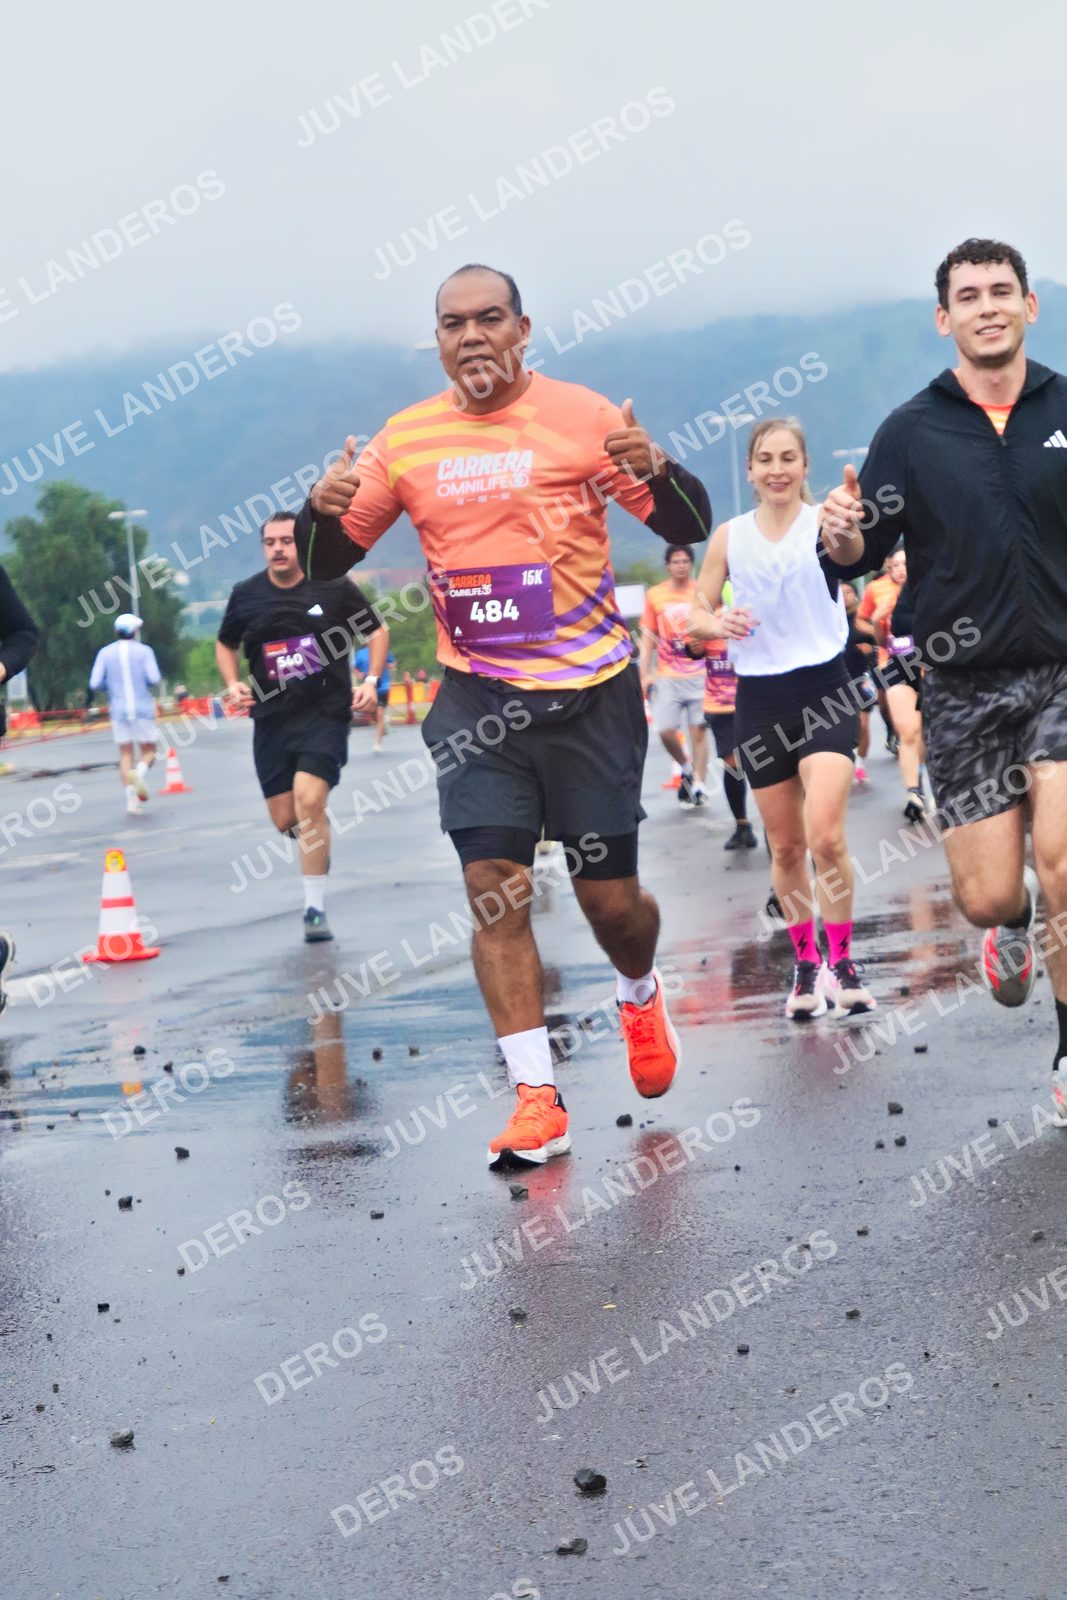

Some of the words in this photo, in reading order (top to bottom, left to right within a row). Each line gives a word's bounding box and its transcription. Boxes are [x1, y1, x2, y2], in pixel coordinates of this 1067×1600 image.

[437, 450, 533, 480] CARRERA
[522, 569, 543, 586] 15K
[470, 598, 520, 623] 484
